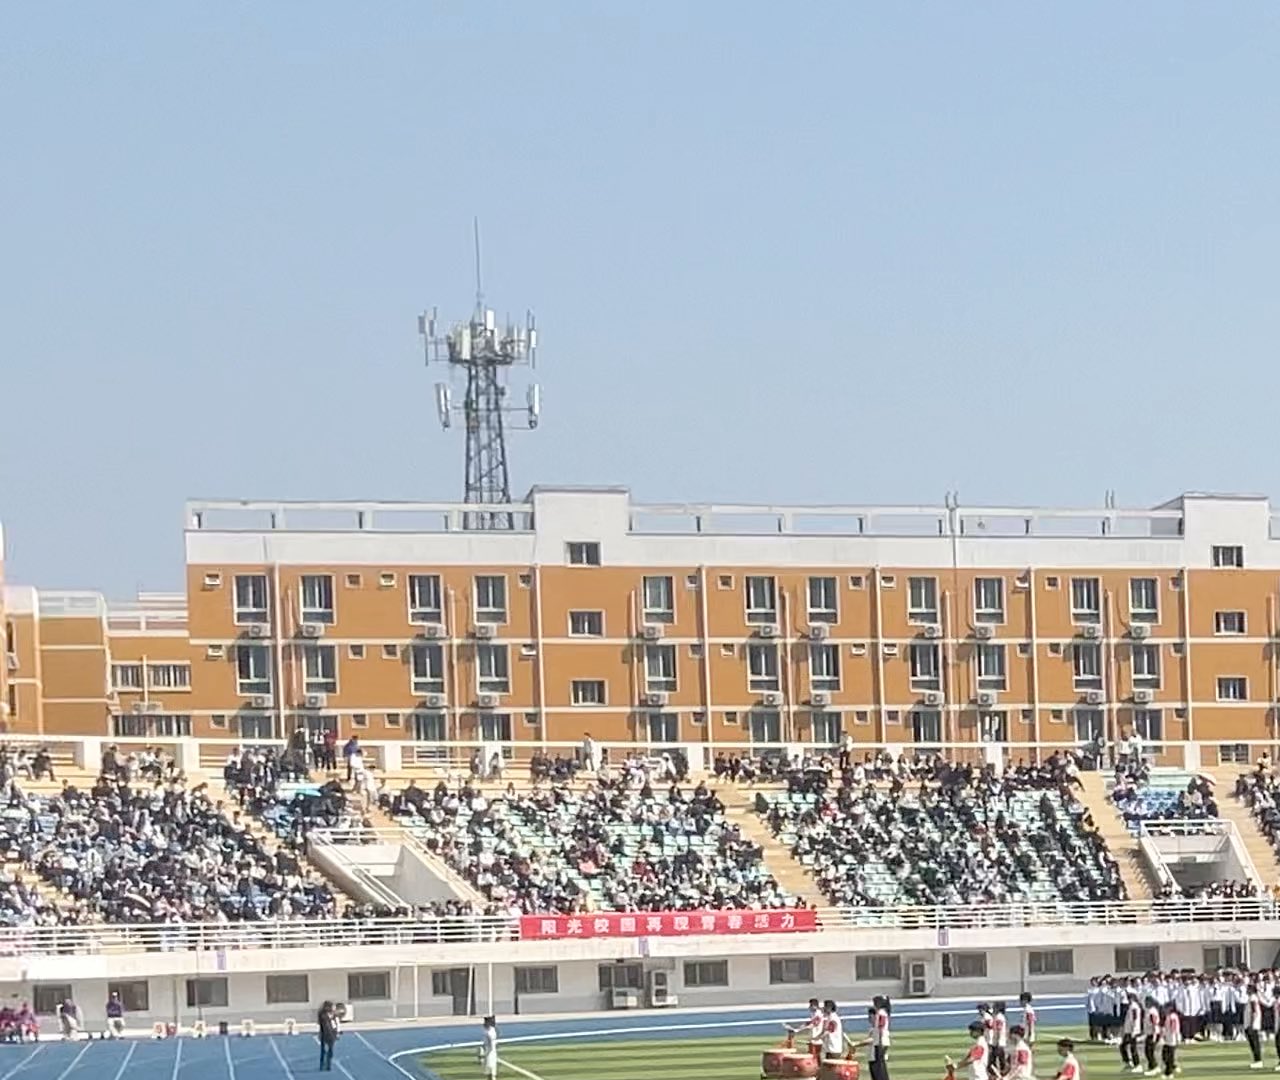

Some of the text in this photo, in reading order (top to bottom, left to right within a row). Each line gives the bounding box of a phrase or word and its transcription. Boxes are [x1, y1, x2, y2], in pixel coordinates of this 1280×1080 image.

[541, 914, 796, 935] 阳光校园再现青春活力
